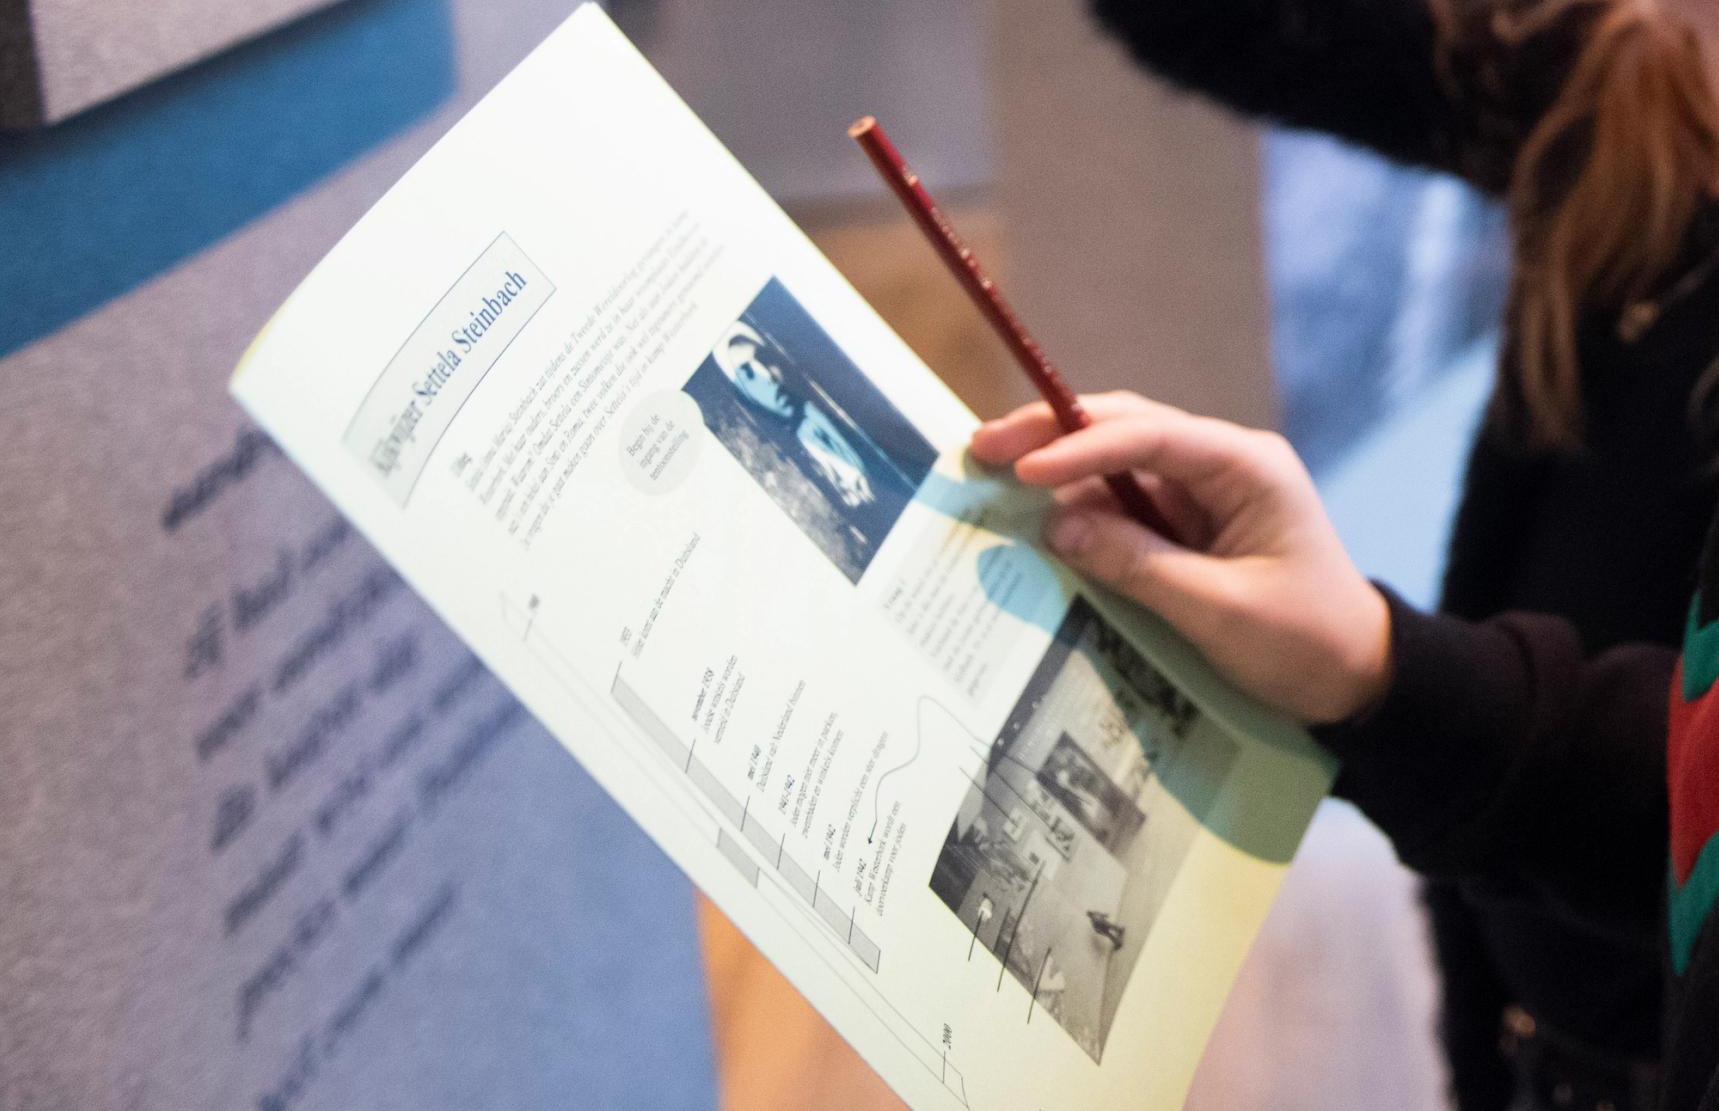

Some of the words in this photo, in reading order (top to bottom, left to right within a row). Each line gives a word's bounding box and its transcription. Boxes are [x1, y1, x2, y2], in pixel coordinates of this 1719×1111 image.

[412, 350, 462, 406] Settela
[452, 271, 527, 354] Steinbach
[941, 1022, 953, 1050] 2000
